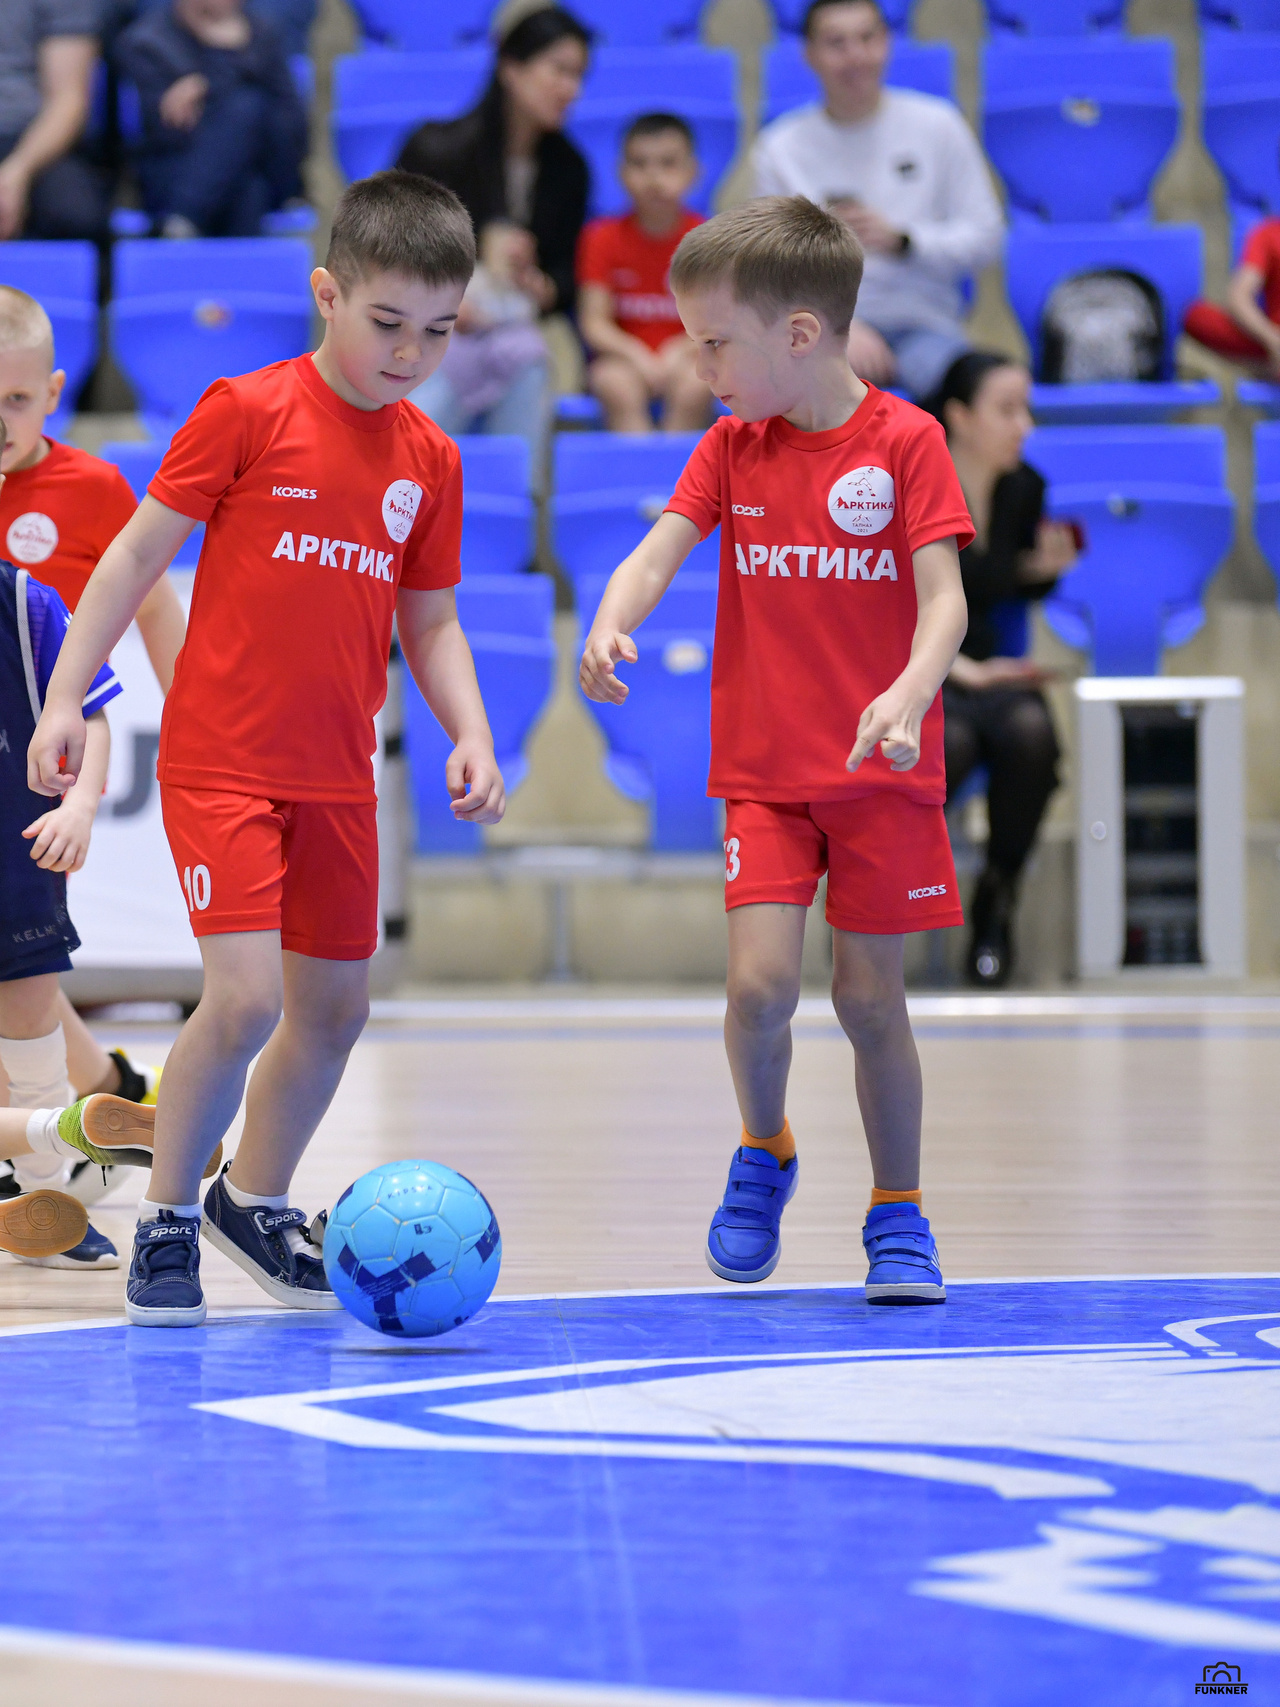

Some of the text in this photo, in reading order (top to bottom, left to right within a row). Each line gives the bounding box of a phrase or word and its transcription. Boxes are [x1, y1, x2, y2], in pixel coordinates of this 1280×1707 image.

[272, 486, 317, 500] KODES
[272, 531, 394, 584] АРКТИК
[735, 543, 898, 582] АРКТИКА
[723, 837, 740, 882] 3
[184, 864, 211, 912] 10
[149, 1226, 192, 1239] sport
[265, 1211, 299, 1228] sport
